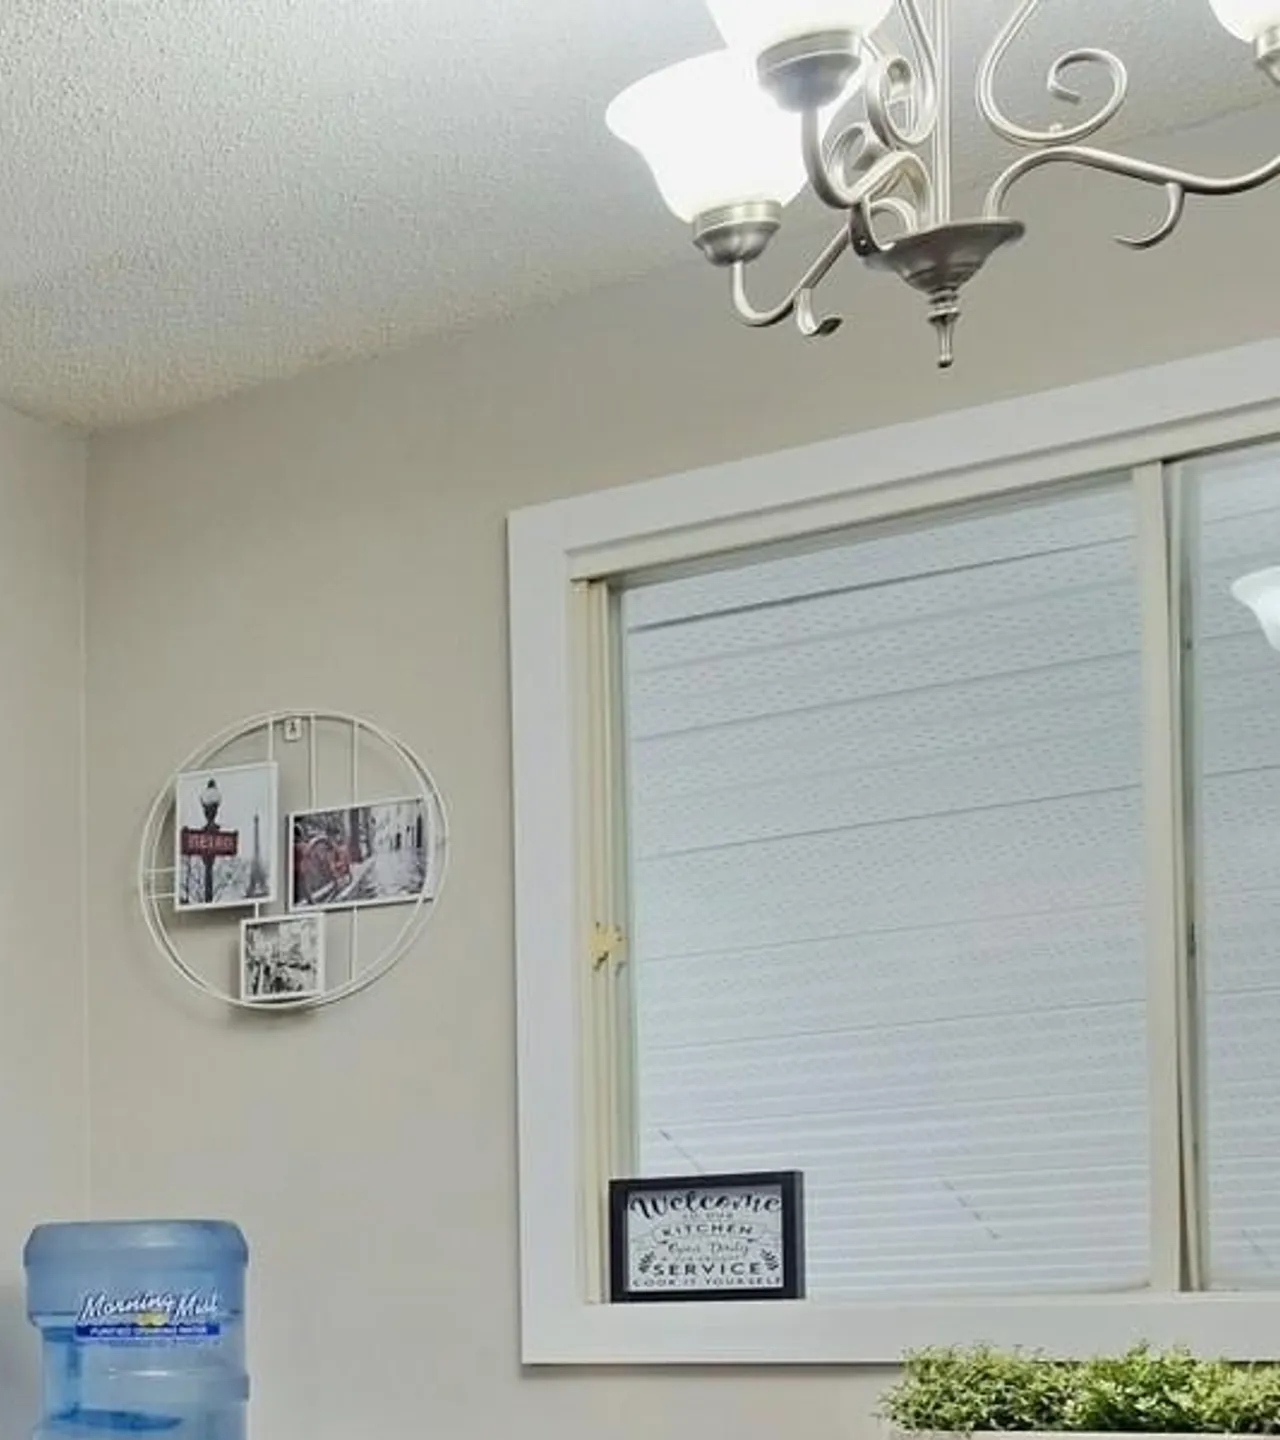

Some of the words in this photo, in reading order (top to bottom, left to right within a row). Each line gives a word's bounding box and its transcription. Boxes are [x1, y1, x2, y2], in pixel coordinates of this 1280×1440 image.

[630, 1190, 782, 1219] Welcome
[662, 1223, 753, 1237] KITCHEN
[652, 1262, 761, 1276] SERVICE
